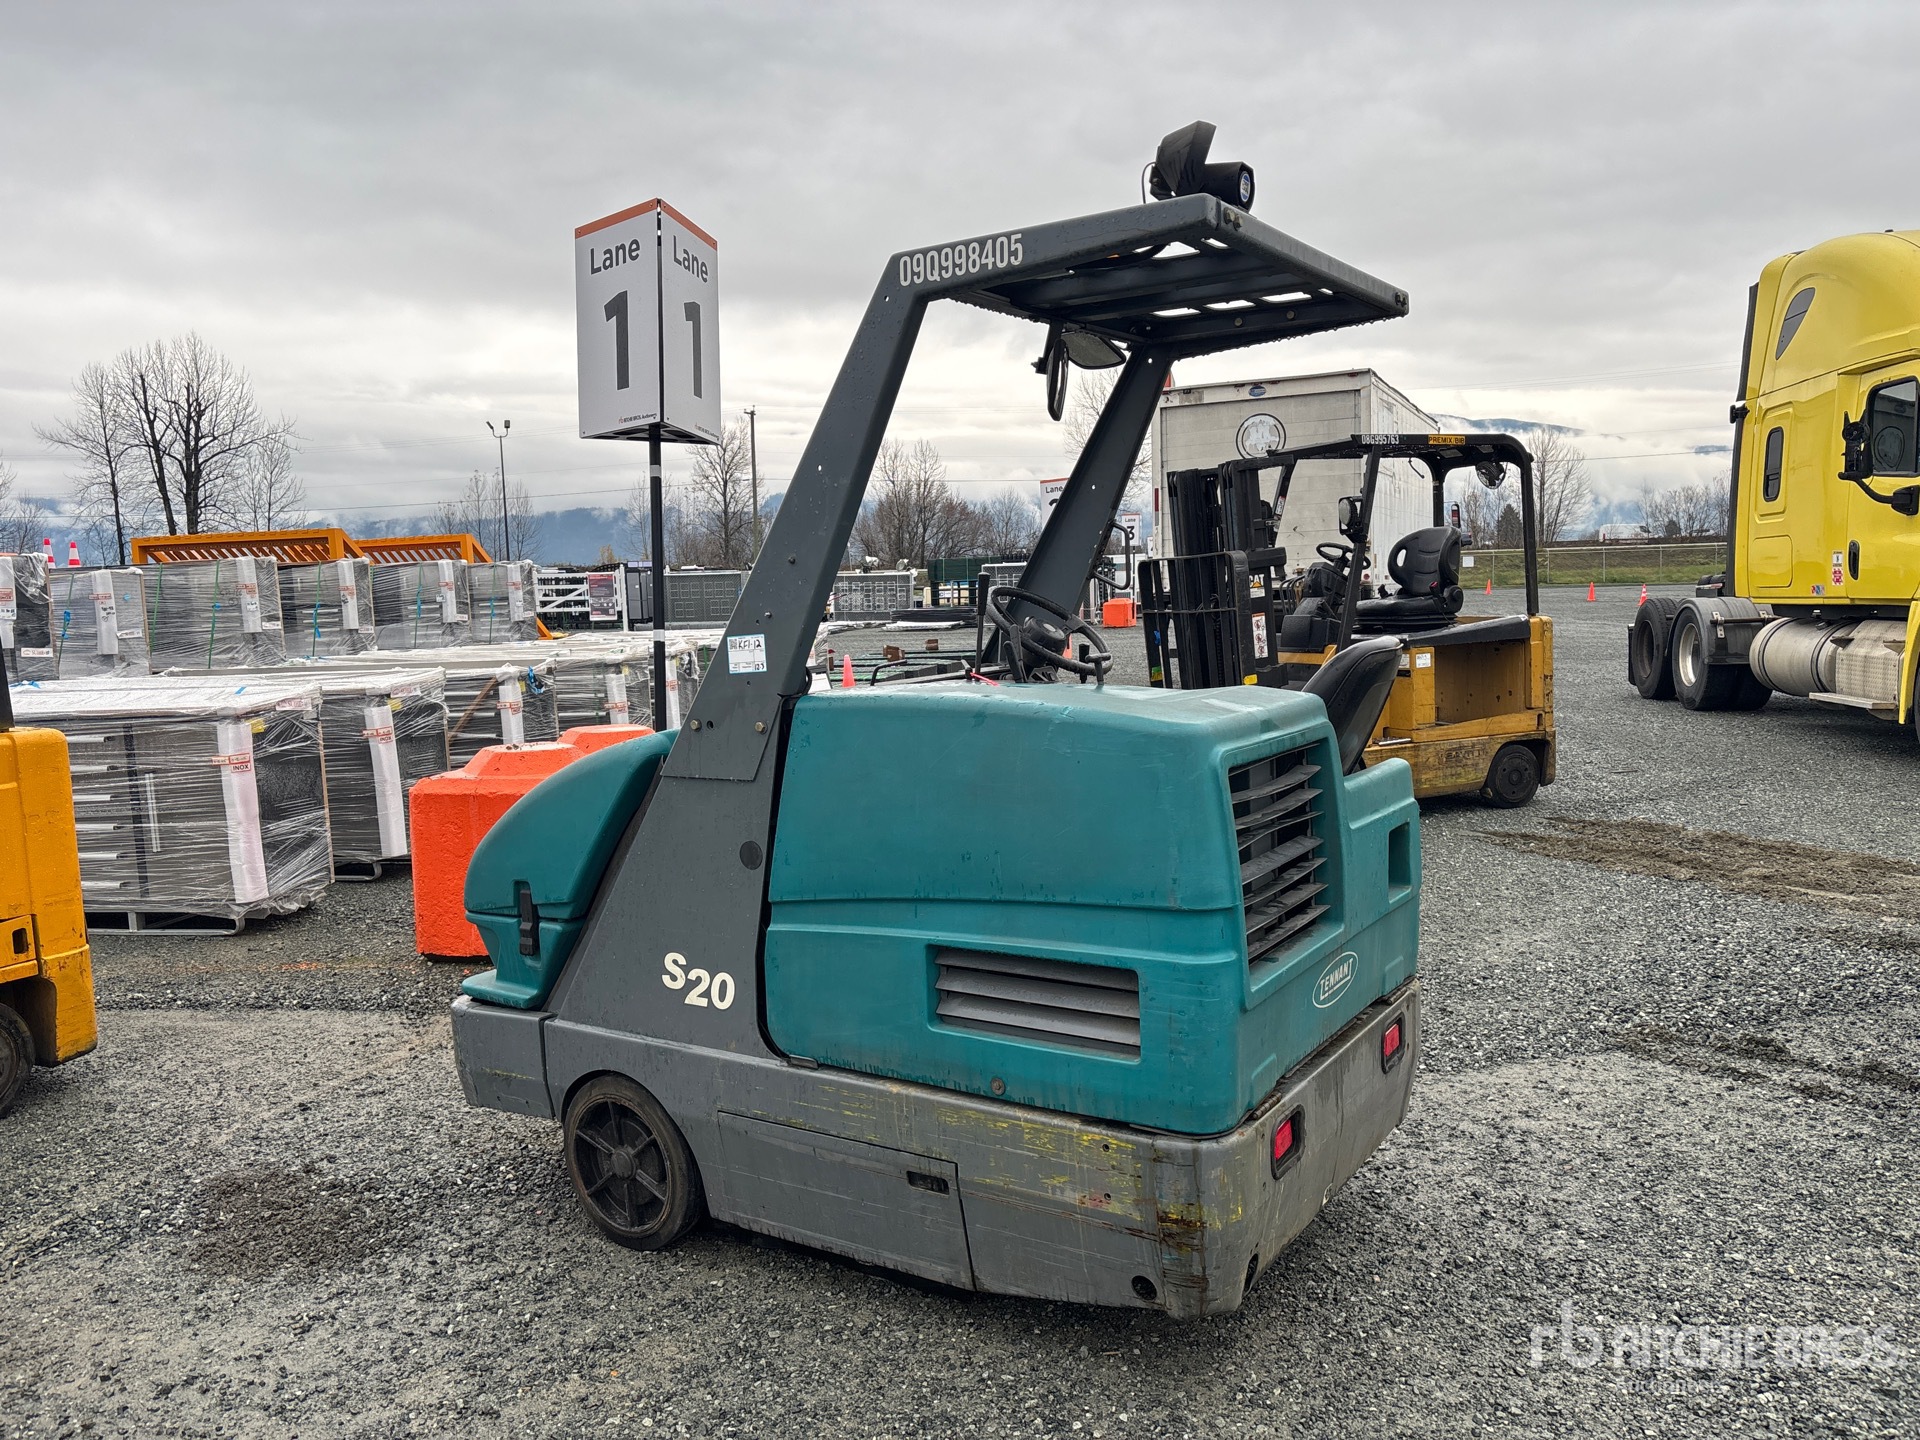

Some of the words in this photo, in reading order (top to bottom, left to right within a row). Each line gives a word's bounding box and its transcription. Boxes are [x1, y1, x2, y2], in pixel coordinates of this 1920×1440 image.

[590, 239, 640, 275] Lane
[673, 235, 708, 283] Lane
[900, 233, 1023, 287] 09Q998405
[603, 290, 630, 390] 1
[683, 301, 703, 399] 1
[1045, 486, 1064, 494] Lane
[1126, 525, 1135, 541] 3
[1249, 574, 1265, 588] CAT
[232, 763, 249, 771] INOX
[661, 952, 736, 1010] S20
[1320, 957, 1354, 1001] TENNANT
